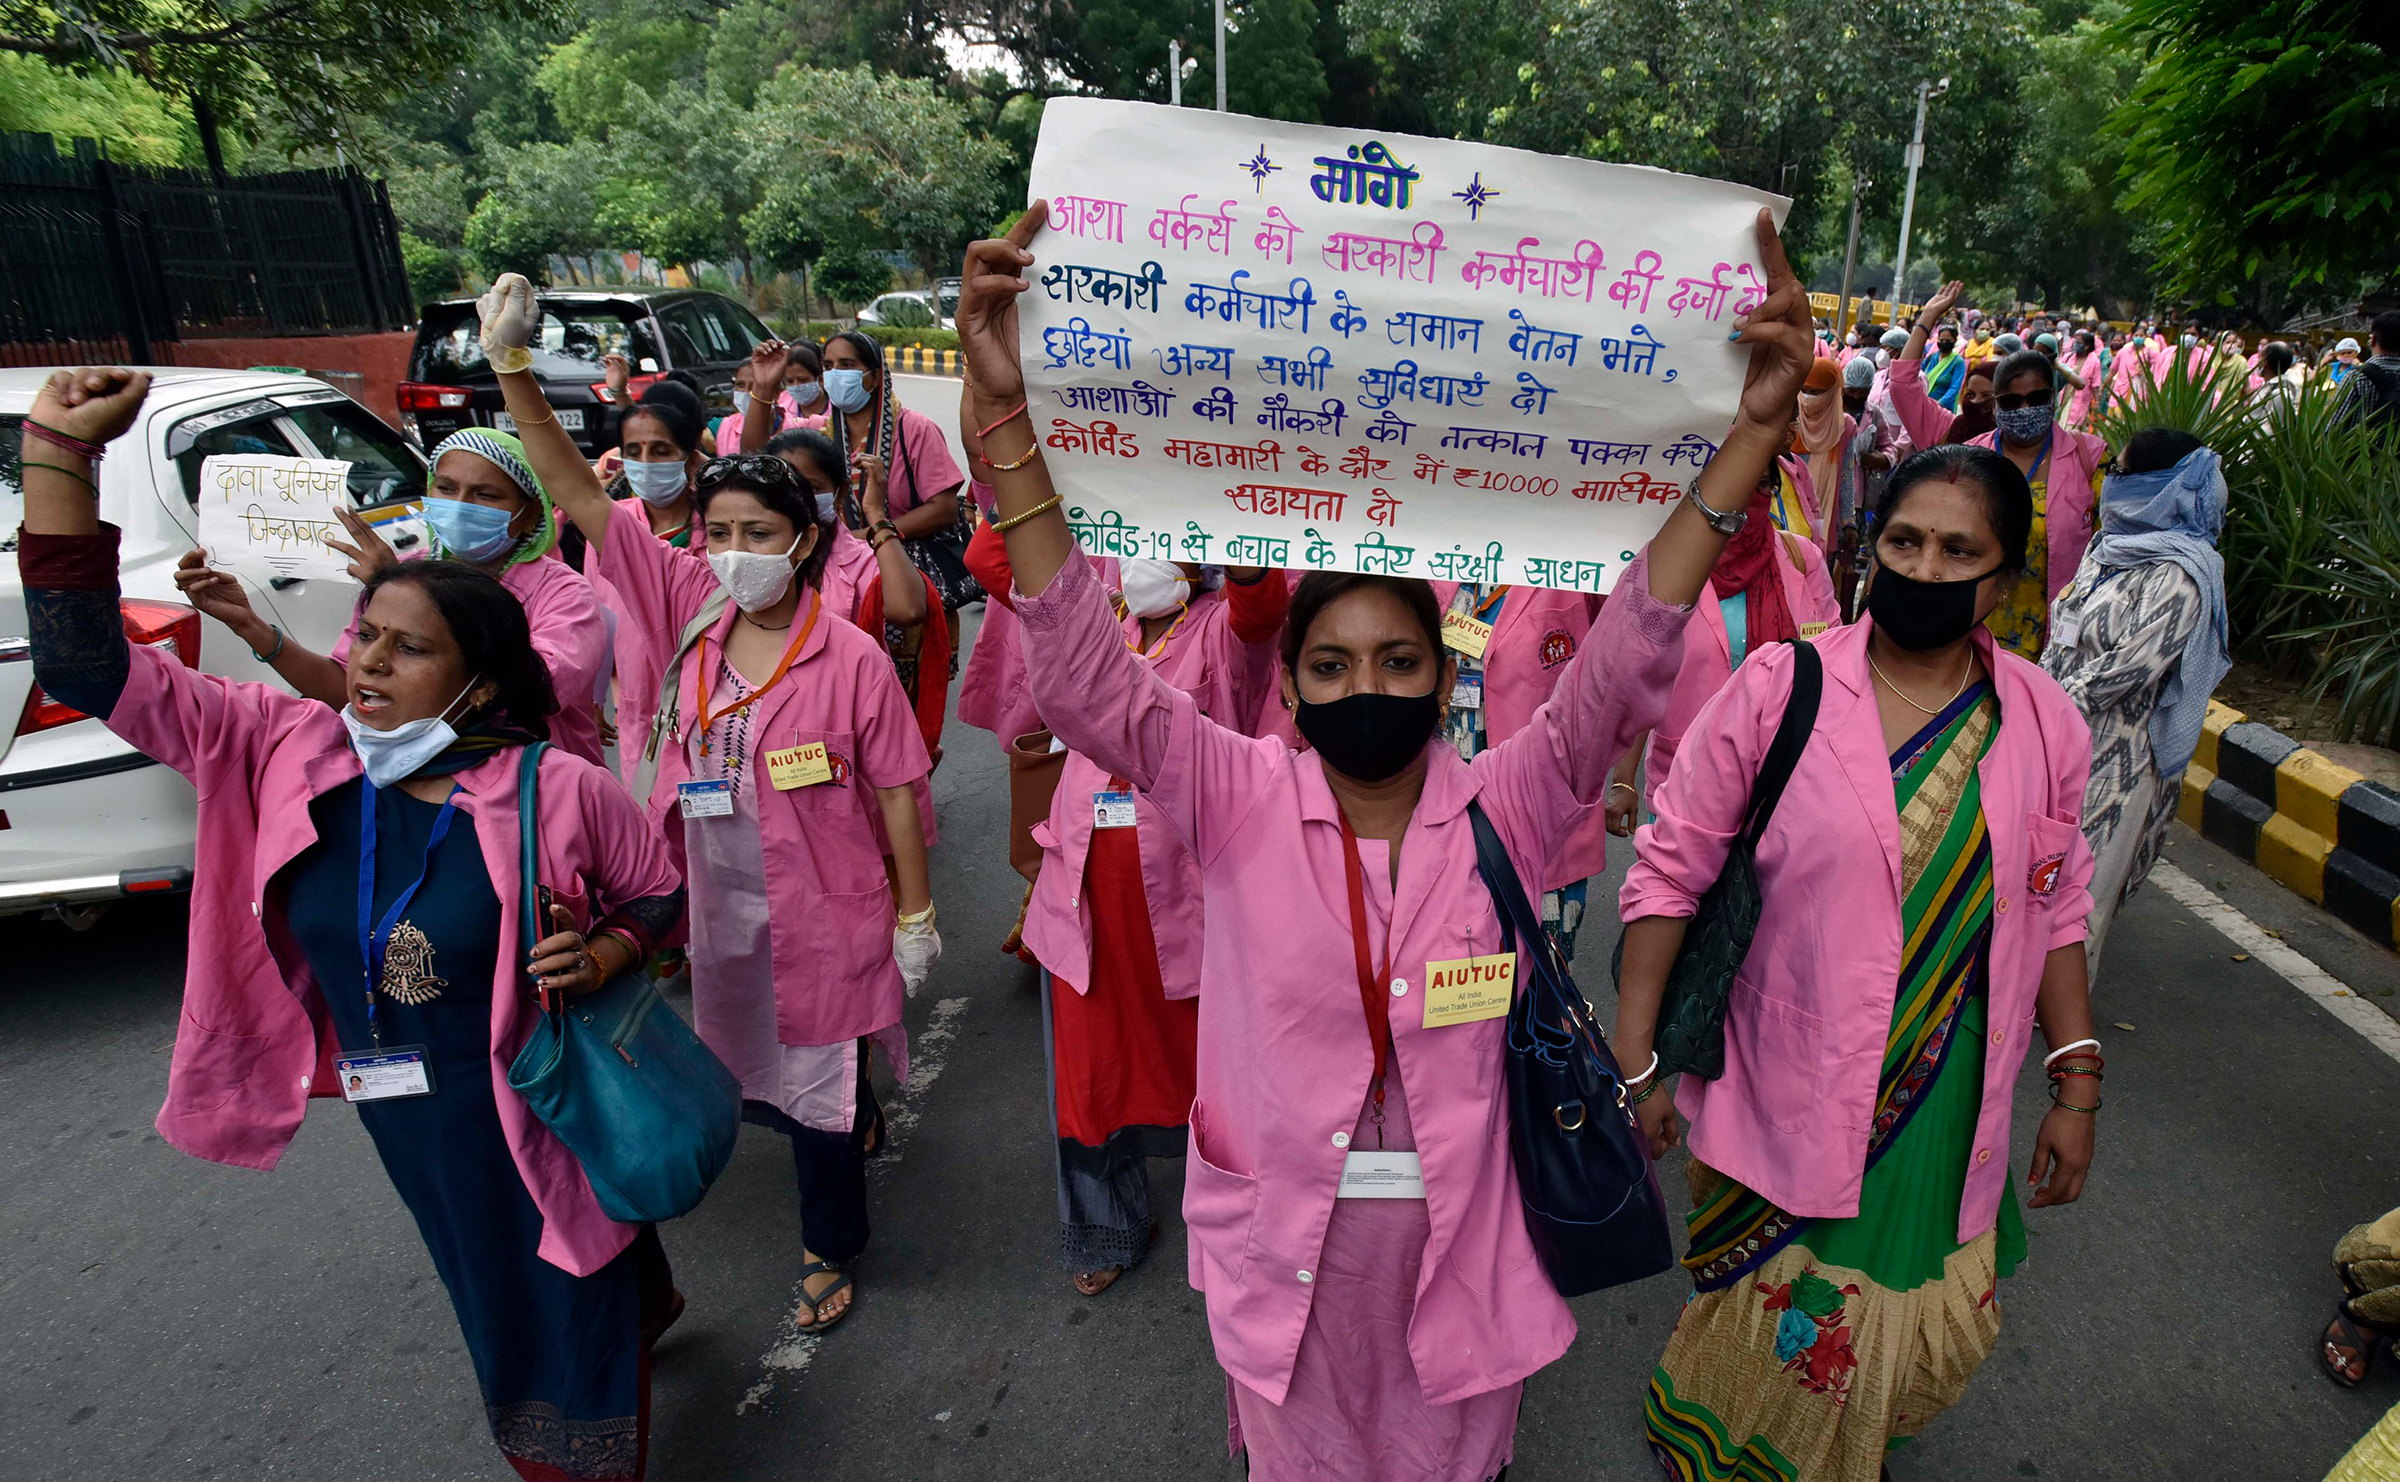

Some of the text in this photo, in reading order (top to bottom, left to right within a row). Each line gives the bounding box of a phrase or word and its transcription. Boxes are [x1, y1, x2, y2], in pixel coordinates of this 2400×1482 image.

[1046, 195, 1128, 244] आशा
[1149, 194, 1238, 255] वर्कर्स
[1254, 206, 1304, 264] को
[1322, 221, 1447, 284] सरकारी
[1462, 237, 1606, 302] कर्मचारी
[1609, 250, 1664, 314] की
[1668, 262, 1734, 320] दर्जा
[1041, 261, 1167, 312] सरकारी
[1185, 269, 1317, 334] कर्मचारी
[1330, 290, 1367, 339] के
[1386, 312, 1484, 353] समान
[1508, 309, 1583, 366] वेतन
[1151, 343, 1235, 380] अन्य
[1256, 346, 1334, 391] सभी
[1511, 372, 1557, 414] दो
[1052, 379, 1719, 469] आशाओं की नौकरी को तत्काल पक्का करो
[1046, 419, 1139, 458] कोविड
[1164, 439, 1285, 471] महामारी
[1298, 445, 1330, 475] के
[1338, 445, 1398, 480] दौर
[1414, 454, 1448, 484] में
[1572, 471, 1682, 504] मासिक
[216, 464, 272, 503] दावा
[1224, 484, 1402, 527] सहायता दो
[1067, 506, 1171, 560] कोविड-19
[1181, 520, 1213, 561] से
[1226, 535, 1290, 567] बचाव
[1305, 528, 1336, 568] के
[1355, 533, 1415, 573] लिए
[1523, 557, 1606, 592] साधन
[1446, 614, 1489, 638] AIUTUC
[771, 748, 823, 767] AIUTUC
[1431, 963, 1510, 989] AIUTUC
[1458, 991, 1482, 1000] All India
[1429, 997, 1507, 1014] United Trade Union Centre
